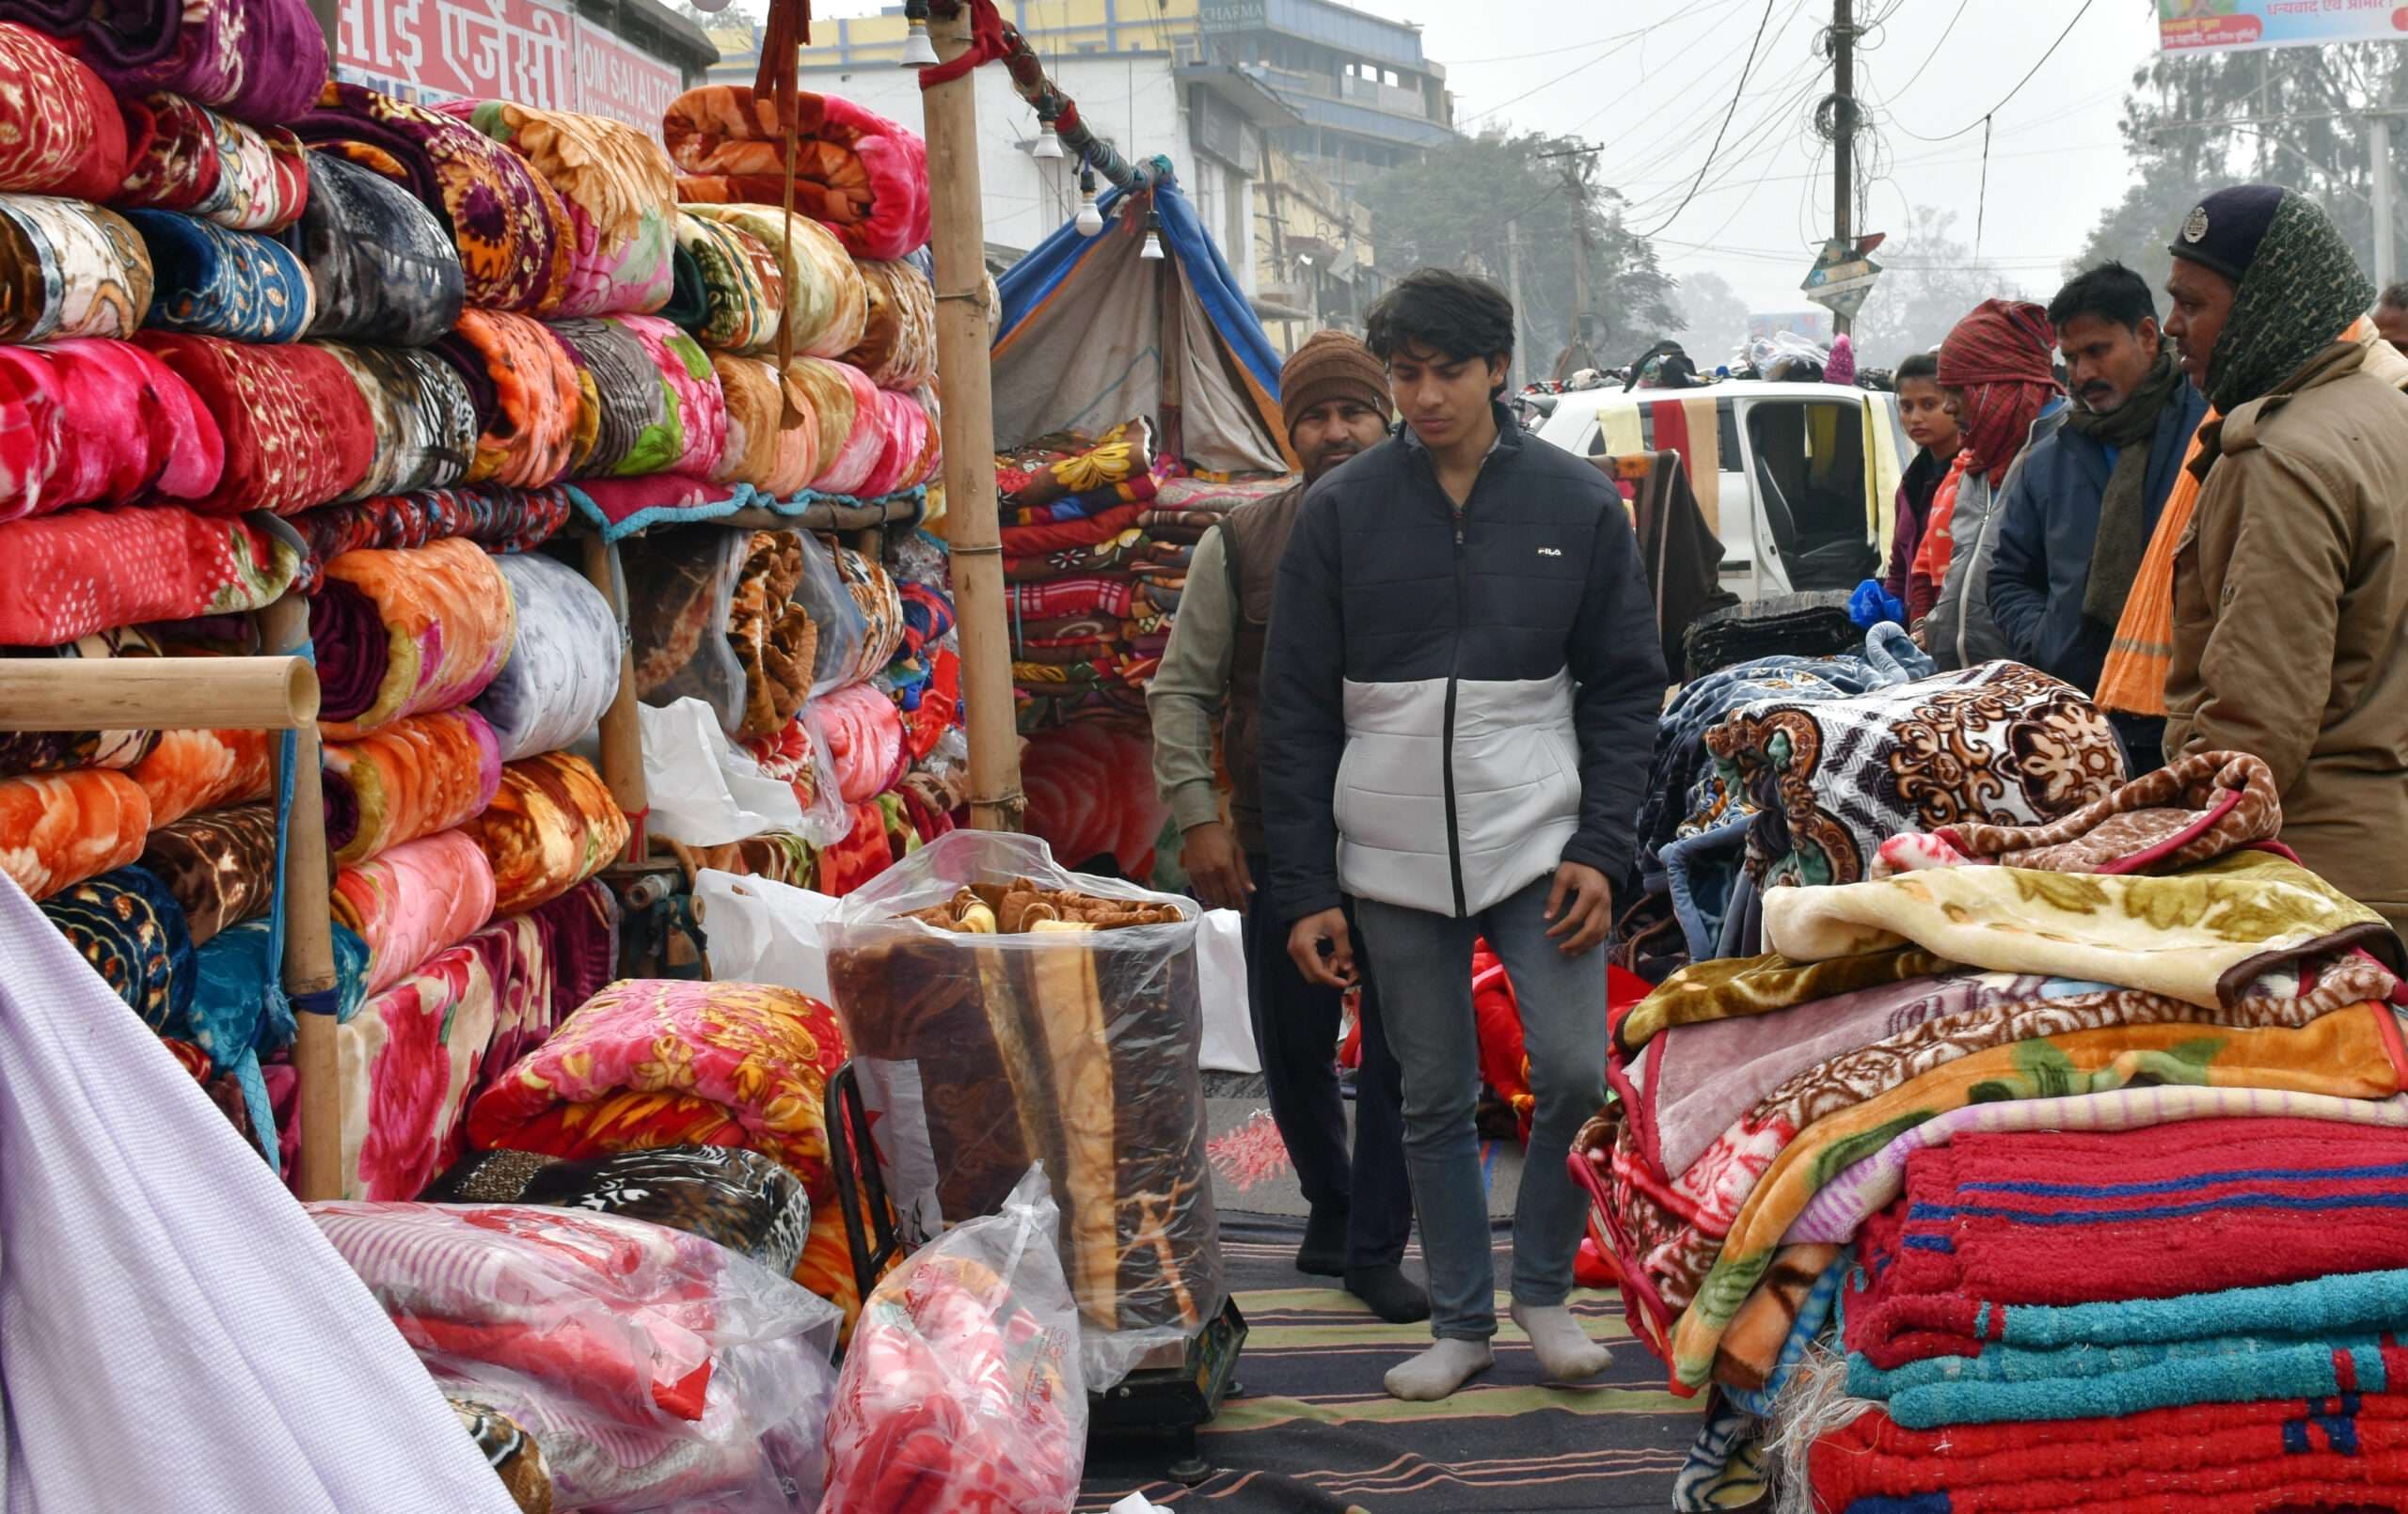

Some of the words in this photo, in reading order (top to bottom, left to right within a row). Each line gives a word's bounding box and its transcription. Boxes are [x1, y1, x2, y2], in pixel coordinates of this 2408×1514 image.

[582, 41, 607, 95] OM
[610, 54, 635, 107] SAI
[1538, 547, 1561, 556] FILA
